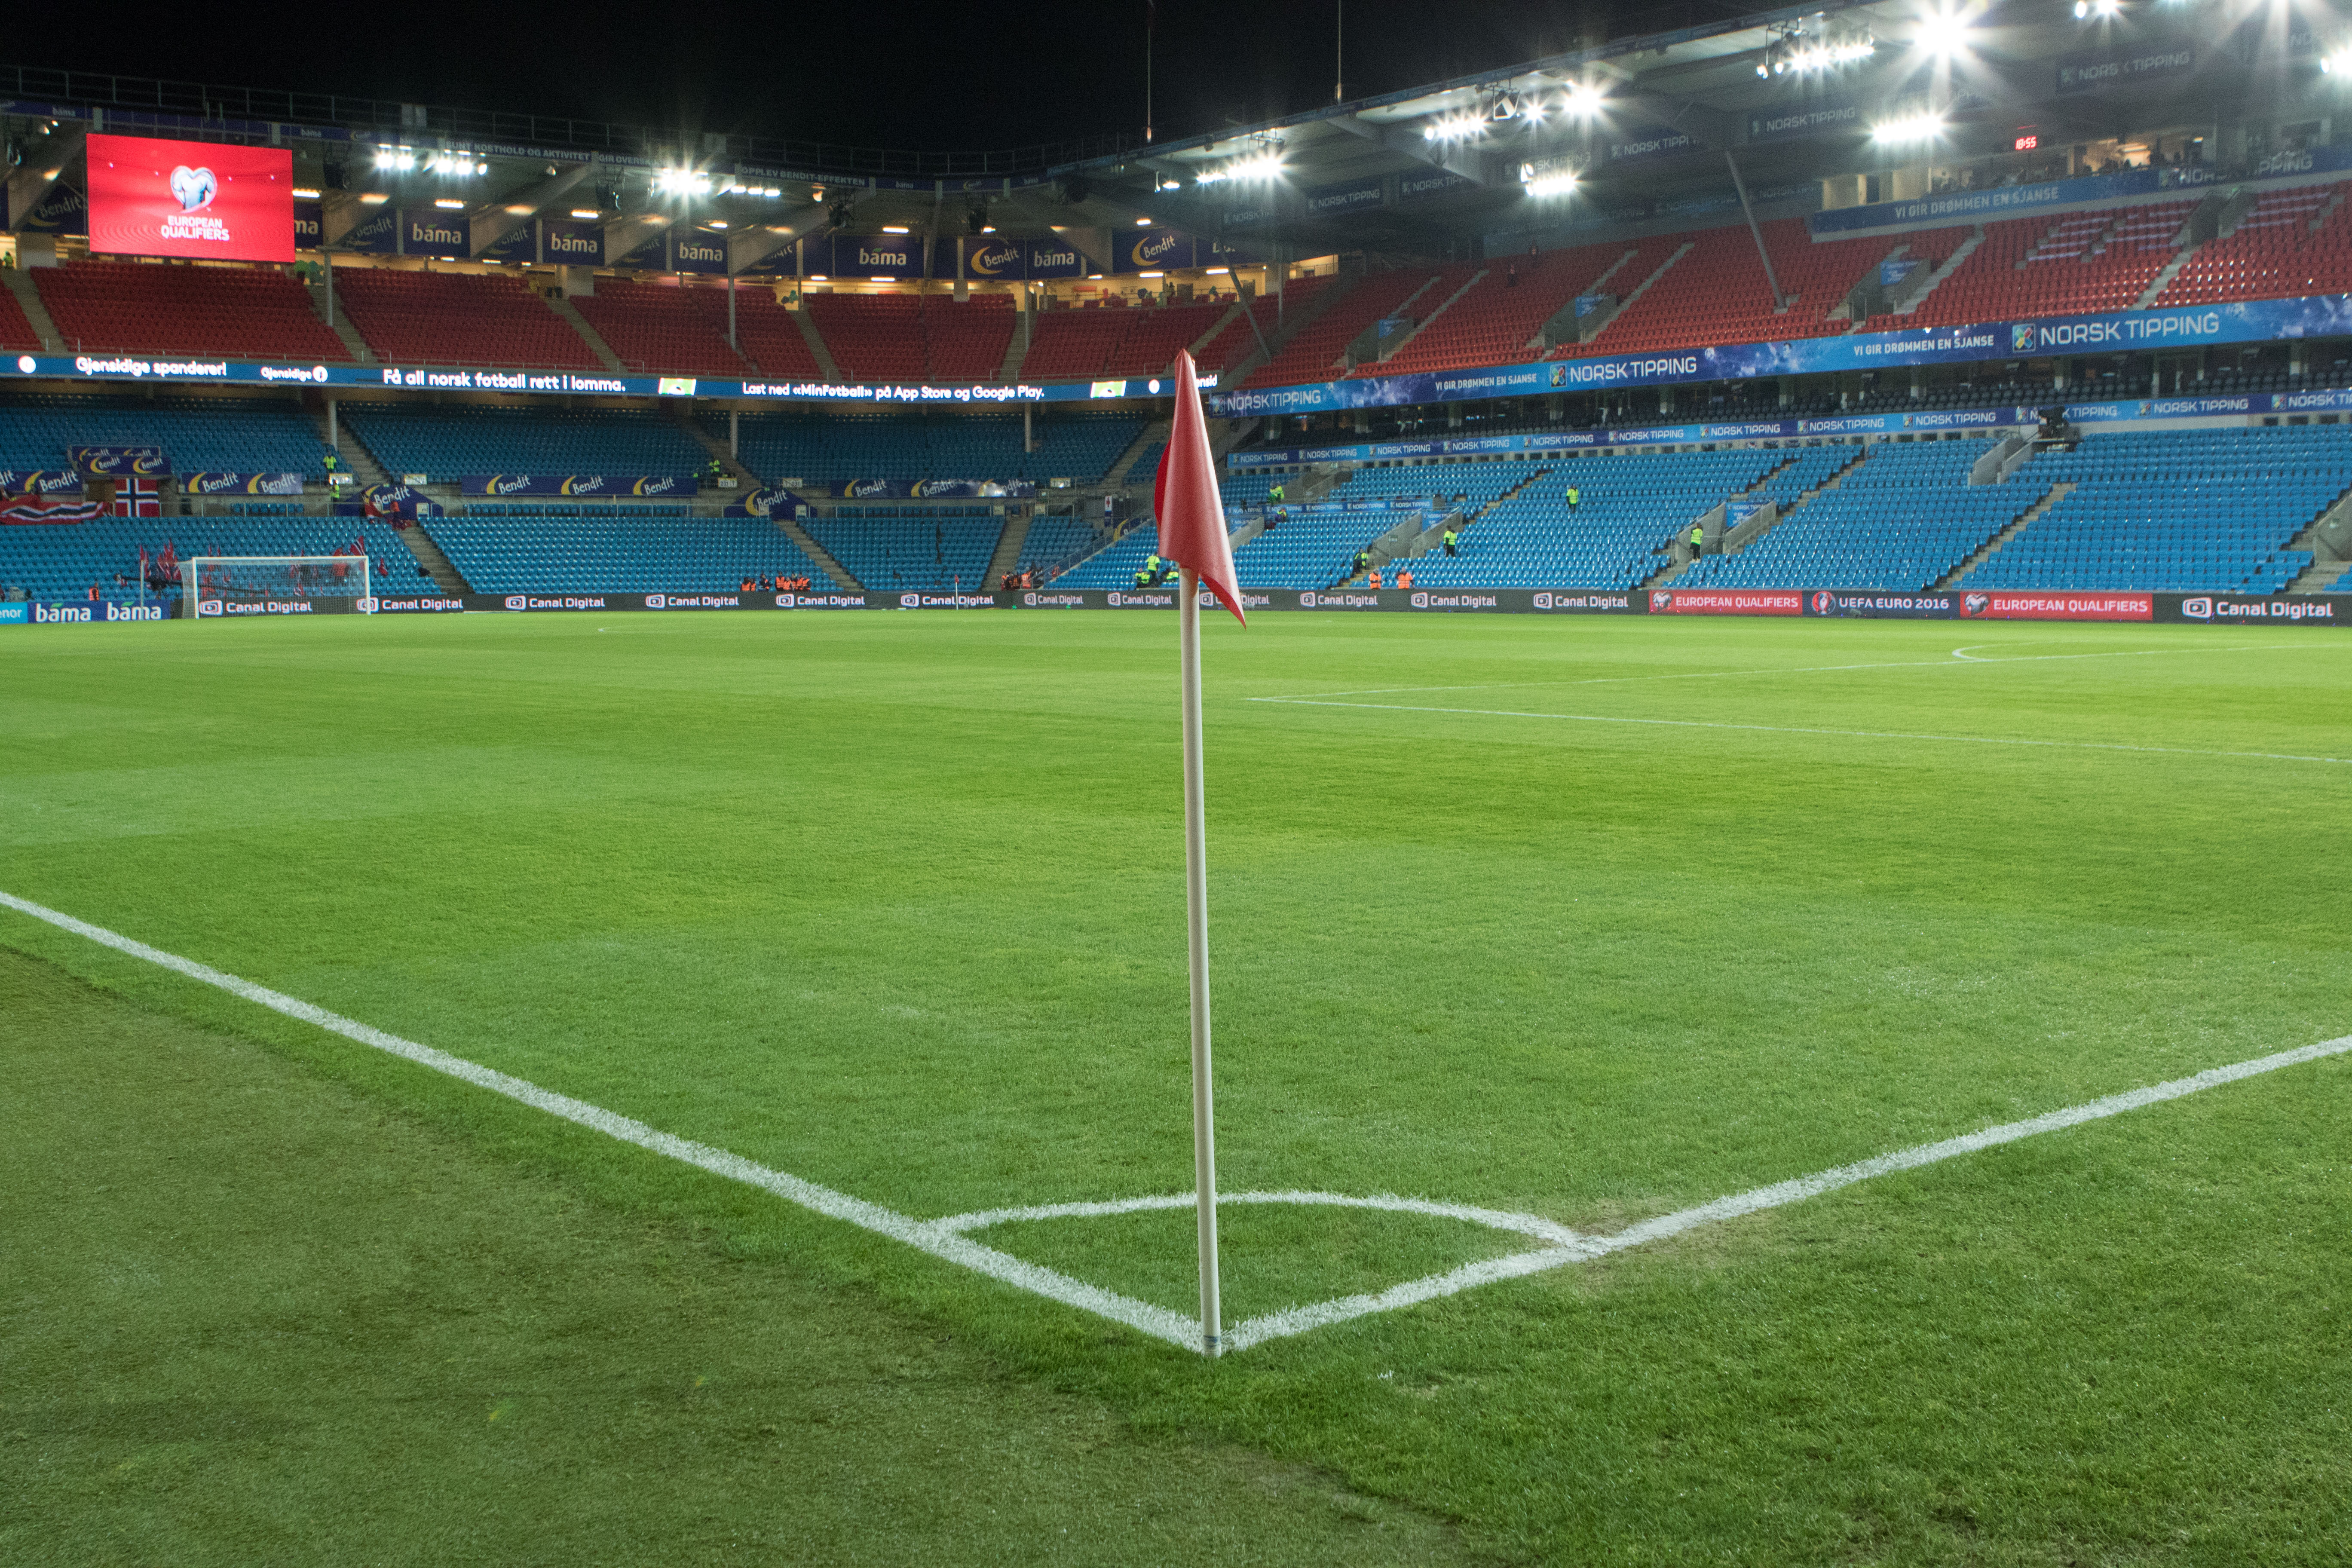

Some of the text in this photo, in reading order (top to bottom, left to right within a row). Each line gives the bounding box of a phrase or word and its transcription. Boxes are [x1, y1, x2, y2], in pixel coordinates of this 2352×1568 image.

[2131, 50, 2190, 72] TIPPING
[1766, 106, 1856, 132] NORSK TIPPING
[1624, 139, 1661, 155] NORSK
[2015, 136, 2037, 150] 18:55
[474, 144, 525, 155] KOSTHOLD
[543, 150, 590, 161] AKTIVITET
[599, 154, 615, 163] GIR
[741, 166, 865, 186] OPPLEV BENDIT-EFFEKTEN
[1412, 177, 1445, 192] NORSK
[1318, 188, 1381, 208] NORSK TIPPING
[1895, 186, 2059, 219] VI GIR DRØMMEN EN SJANSE
[168, 215, 223, 230] EUROPEAN
[161, 224, 230, 242] QUALIFIERS
[413, 222, 462, 244] bama
[551, 232, 597, 253] bama
[1143, 235, 1176, 258] Bendit
[679, 242, 723, 262] bama
[859, 247, 907, 265] bama
[984, 247, 1020, 267] Bendit
[1034, 250, 1075, 268] bama
[2041, 314, 2220, 346] NORSK TIPPING
[1854, 334, 1995, 356] VI GIR DRØMMEN EN SJANSE
[76, 356, 227, 377] Gjensidige spanderer!
[260, 366, 312, 382] Gjensidige
[1570, 356, 1697, 383] NORSK TIPPING
[383, 368, 626, 392] Få all norsk fotball rett i lomma.
[1436, 373, 1537, 390] VI GIR DRØMMEN EN SJANSE
[742, 381, 1045, 403] Last ned «MinFotball» på App Store og Google Play.
[1227, 389, 1321, 411] NORSK TIPPING
[2154, 398, 2249, 413] NORSK TIPPING
[2288, 395, 2335, 407] NORSK
[1915, 411, 1997, 426] NORSK TIPPING
[2073, 405, 2118, 419] TIPPING
[1711, 423, 1780, 436] NORSK TIPPING
[1810, 418, 1885, 431] NORSK TIPPING
[1533, 434, 1594, 446] NORSK TIPPING
[1619, 429, 1684, 441] NORSK TIPPING
[1307, 448, 1357, 459] NORSK TIPPING
[1377, 444, 1431, 455] NORSK TIPPING
[1452, 439, 1510, 451] NORSK TIPPING
[98, 456, 121, 470] Bendit
[141, 456, 164, 470] Bendit
[1240, 453, 1288, 463] NORSK TIPPING
[39, 471, 79, 492] Bendit
[202, 472, 240, 493] Bendit
[260, 472, 297, 493] Bendit
[499, 475, 531, 495] Bendit
[573, 475, 604, 495] Bendit
[645, 476, 675, 496] Bendit
[855, 479, 887, 497] Bendit
[923, 479, 954, 497] Bendit
[374, 486, 410, 505] Bendit
[757, 490, 788, 508] Bendit
[226, 601, 313, 615] Canal Digital
[382, 598, 463, 611] Canal Digital
[529, 597, 606, 609] Canal Digital
[668, 595, 740, 608] Canal Digital
[797, 595, 866, 607] Canal Digital
[922, 595, 994, 607] Canal Digital
[1038, 595, 1083, 605] Canal Digital
[1122, 594, 1172, 606] Canal Digital
[1318, 594, 1378, 606] Canal Digital
[1430, 595, 1497, 608] Canal Digital
[1555, 596, 1629, 609] Canal Digital
[1676, 596, 1798, 608] EUROPEAN QUALIFIERS
[1838, 597, 1950, 609] UEFA EURO 2016
[1993, 599, 2148, 612] EUROPEAN QUALIFIERS
[35, 603, 91, 623] bama
[107, 601, 162, 621] bama
[2216, 601, 2334, 620] Canal Digital
